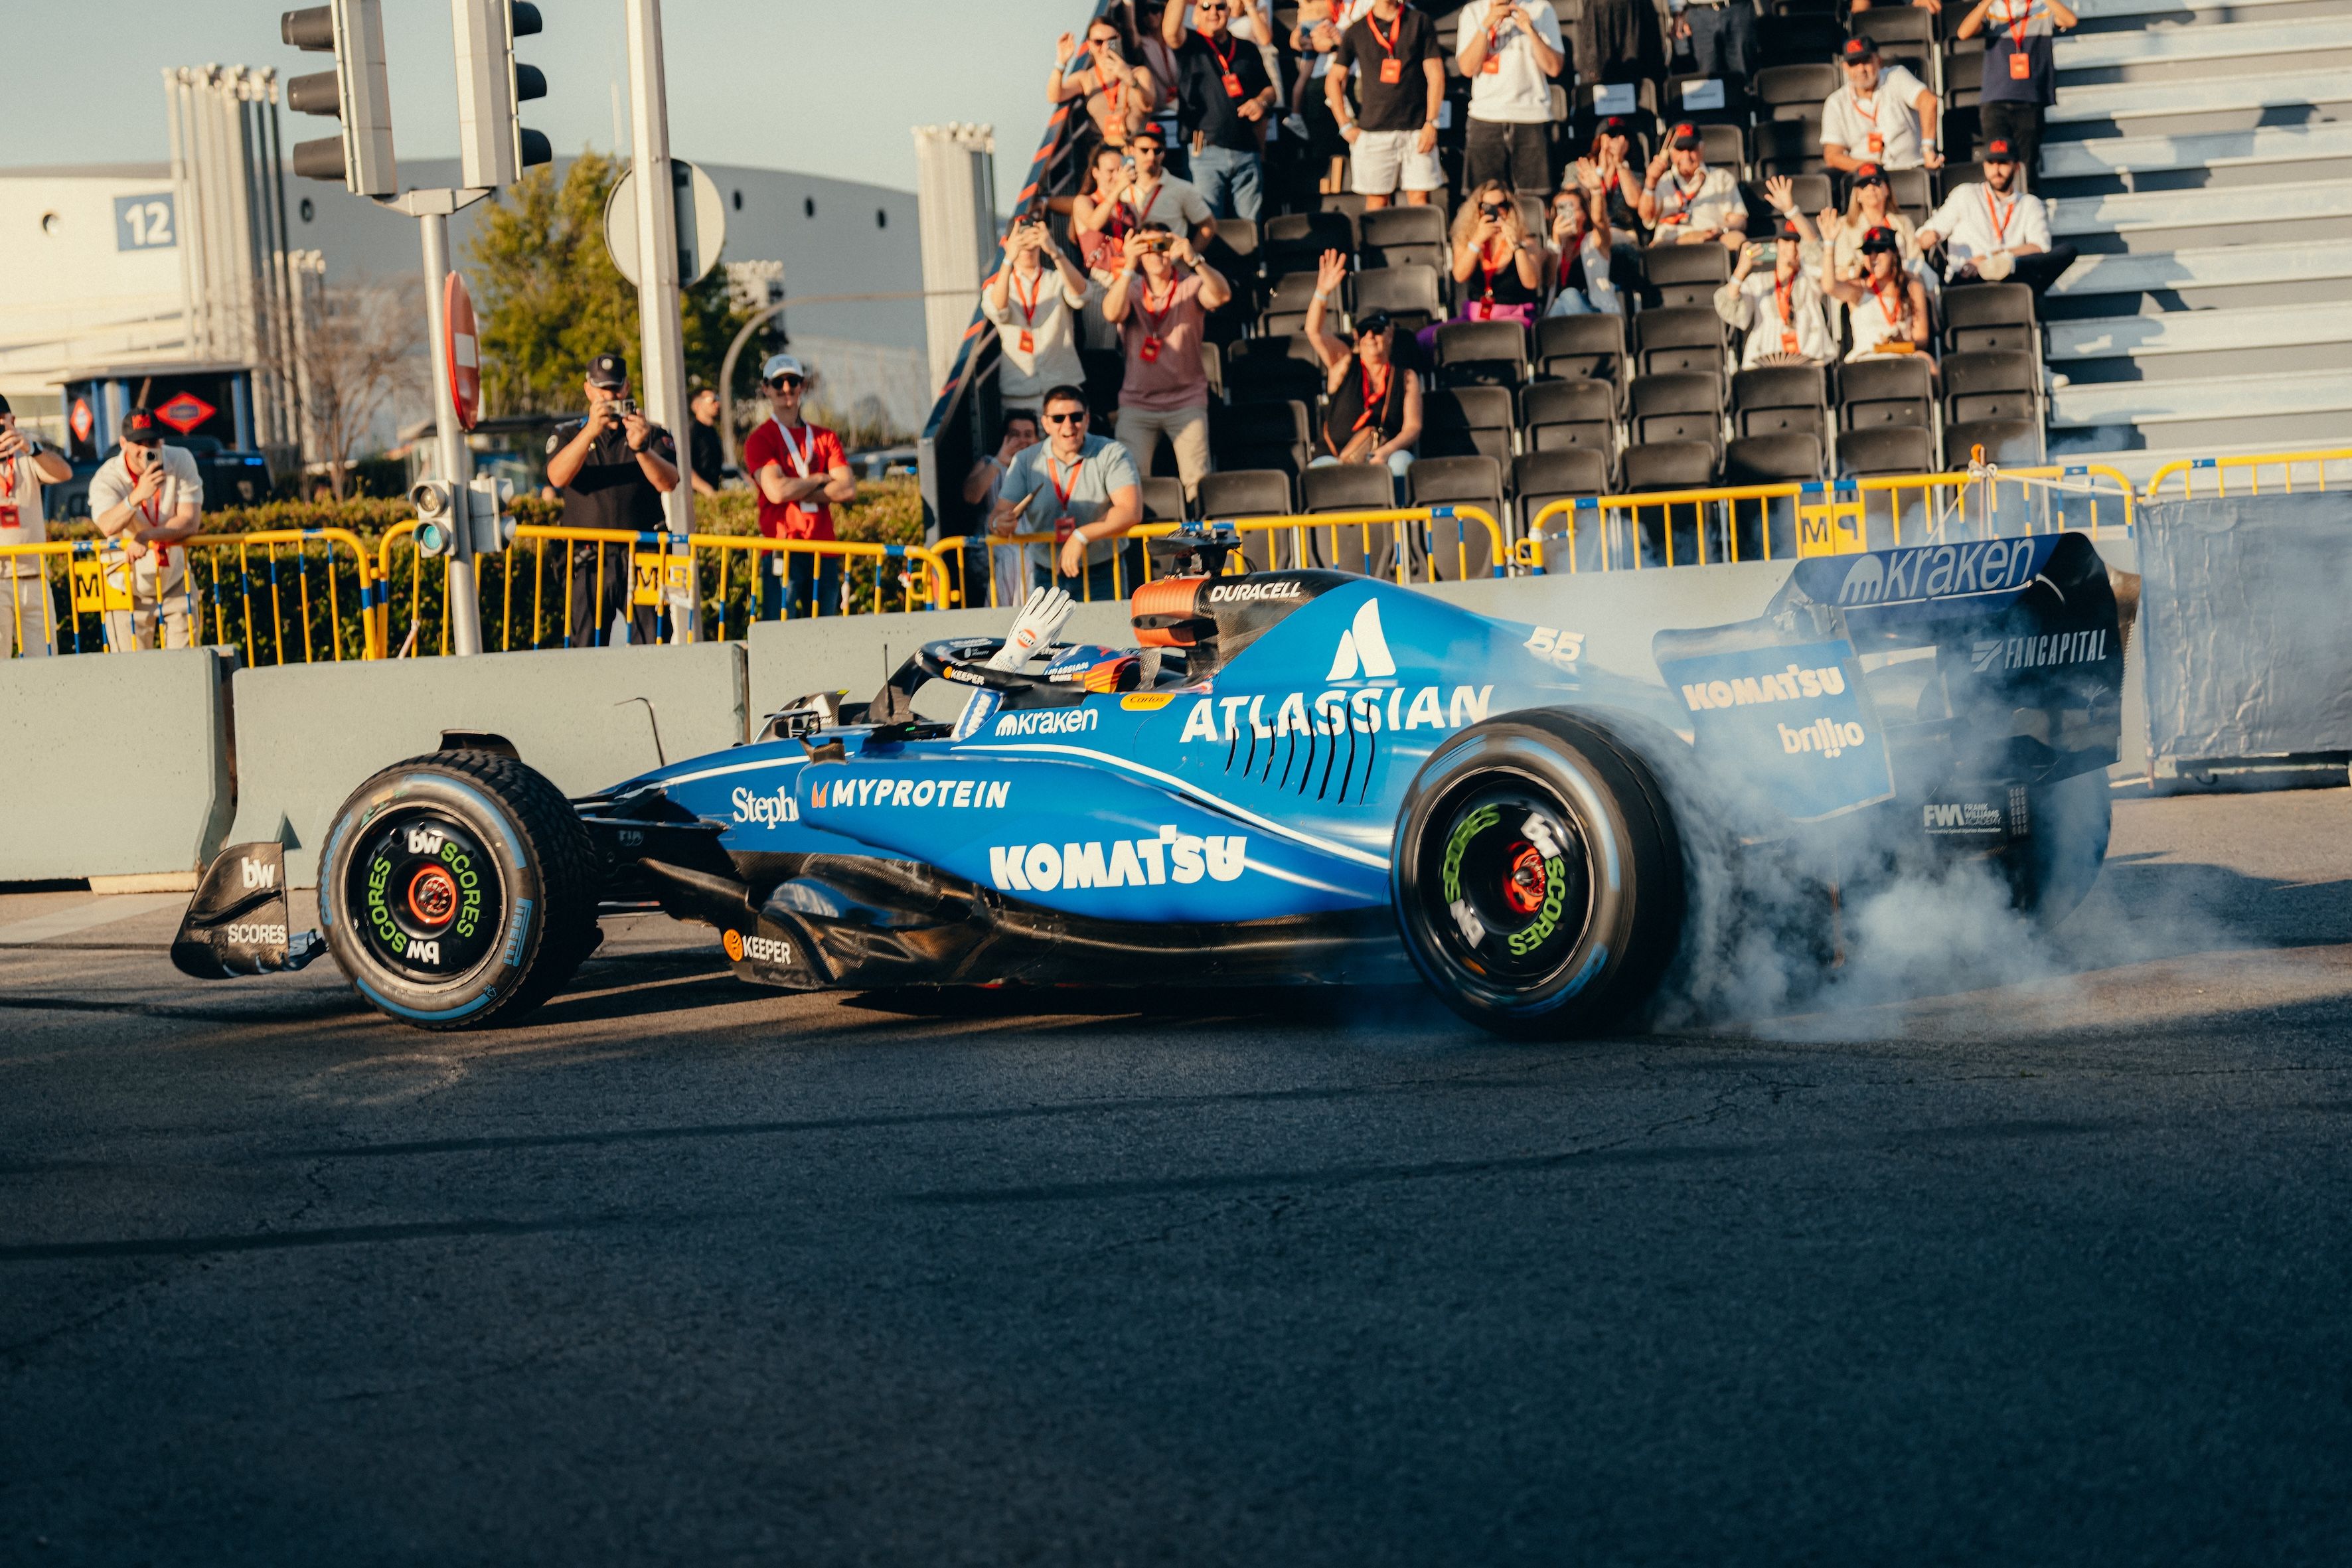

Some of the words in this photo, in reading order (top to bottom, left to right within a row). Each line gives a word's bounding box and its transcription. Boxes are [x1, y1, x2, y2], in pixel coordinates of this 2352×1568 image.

[124, 202, 173, 246] 12
[1887, 538, 2035, 598] kraken
[1209, 582, 1301, 603] DURACELL
[1522, 626, 1585, 662] 55
[2004, 629, 2107, 669] FANCAPITAL
[951, 668, 984, 685] KEEPER
[1682, 664, 1845, 711] KOMATSU
[1130, 695, 1165, 704] Carlos
[1179, 684, 1494, 744] ATLASSIAN
[1016, 708, 1098, 735] kraken
[832, 779, 1010, 809] MYPROTEIN
[242, 857, 275, 889] bw
[989, 824, 1247, 892] KOMATSU
[408, 828, 443, 855] bw
[441, 842, 481, 939] SCORES
[368, 856, 407, 953] SCORES
[1509, 856, 1567, 956] SCORES
[228, 924, 286, 945] SCORES
[503, 898, 534, 967] PIRELLI
[742, 935, 791, 965] KEEPER
[407, 940, 440, 965] bw
